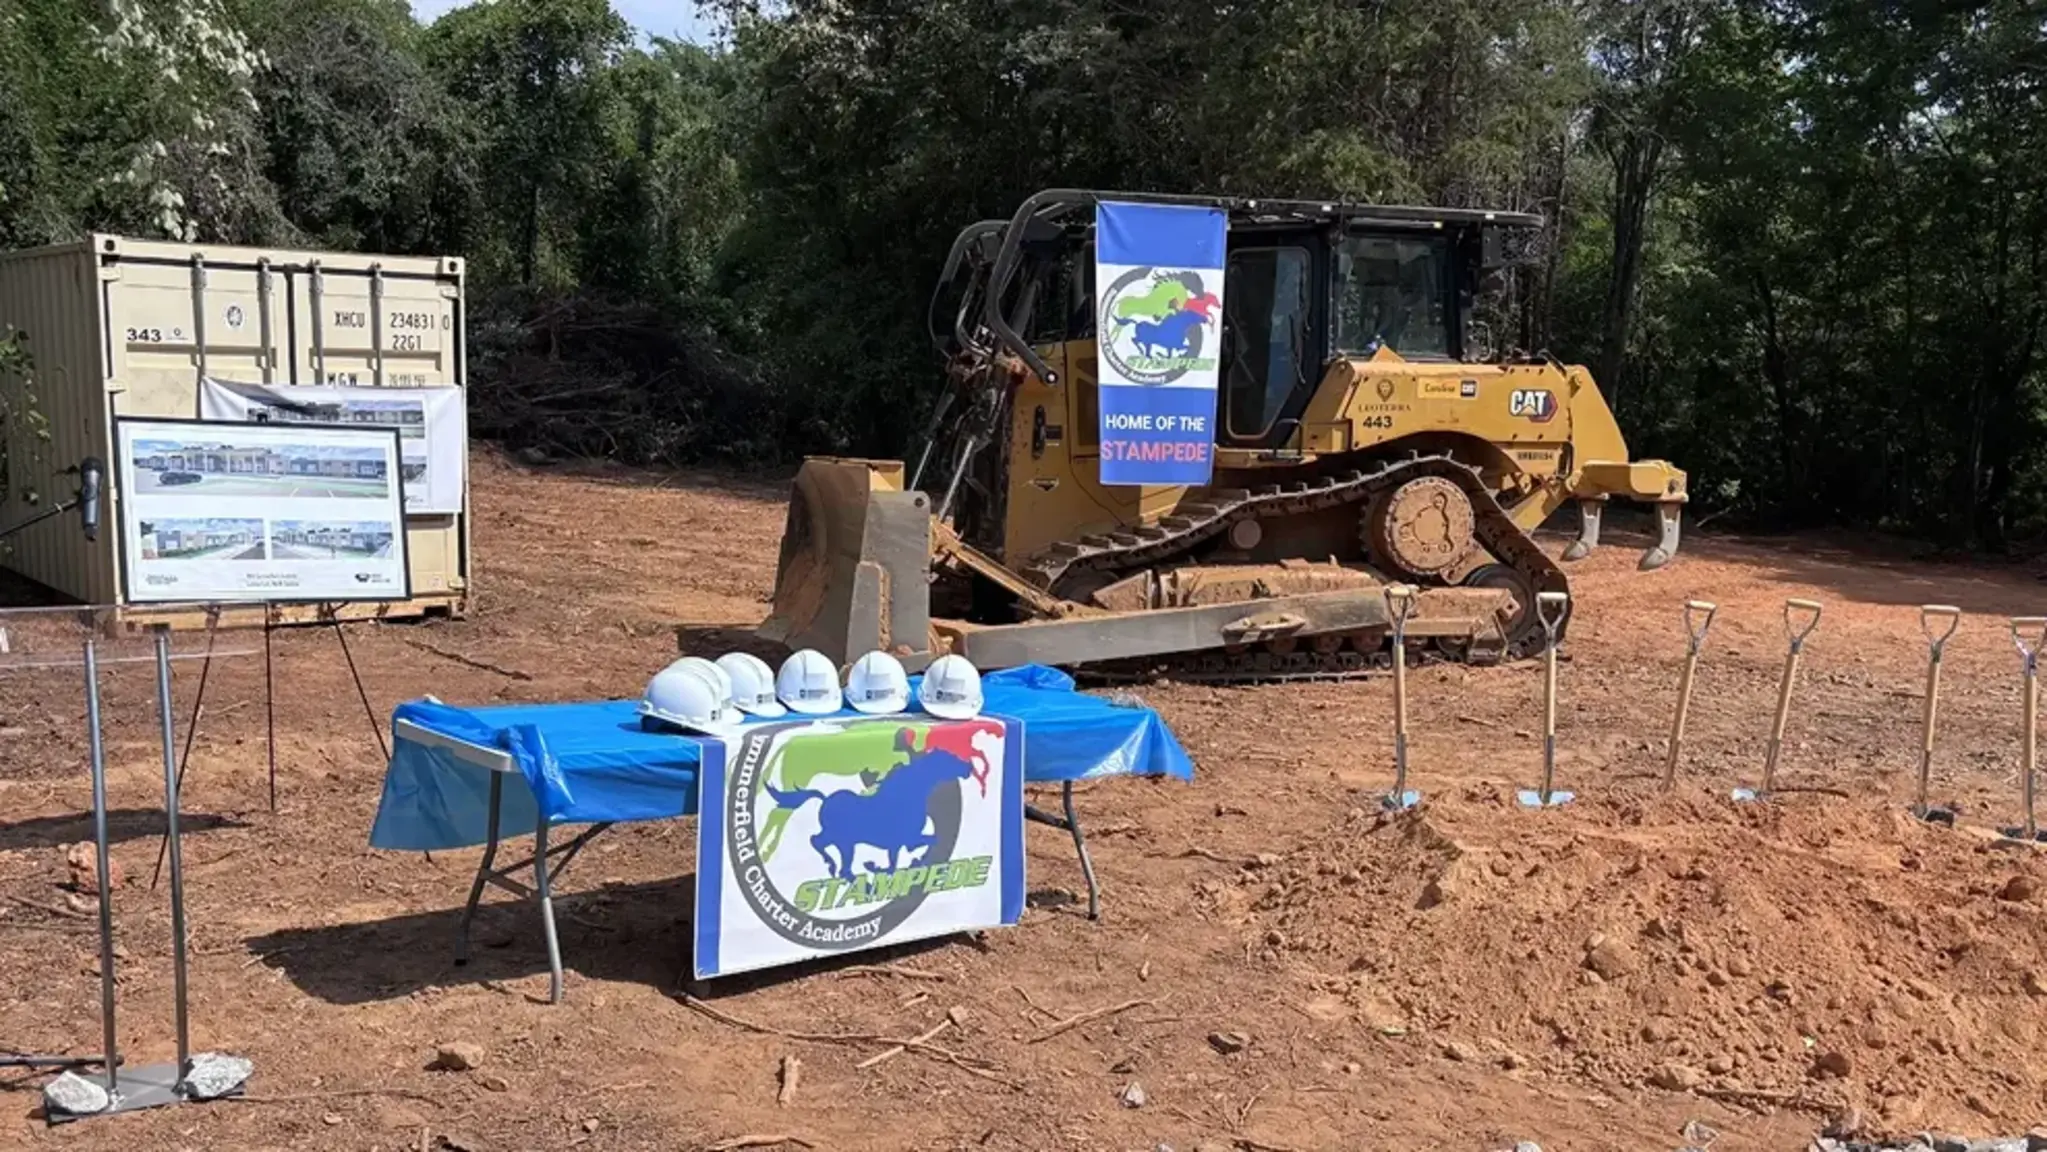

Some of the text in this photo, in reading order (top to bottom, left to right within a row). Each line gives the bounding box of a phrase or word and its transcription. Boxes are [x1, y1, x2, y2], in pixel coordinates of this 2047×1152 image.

[334, 311, 365, 328] XHCU
[390, 312, 434, 330] 234831
[127, 327, 162, 342] 343
[1510, 390, 1547, 416] CAT
[1105, 414, 1206, 432] HOME OF THE
[1362, 415, 1393, 429] 443
[1101, 440, 1208, 462] STAMPEDE
[734, 734, 883, 941] mmerfield Charter Academy
[793, 855, 994, 913] STAMPEDE
